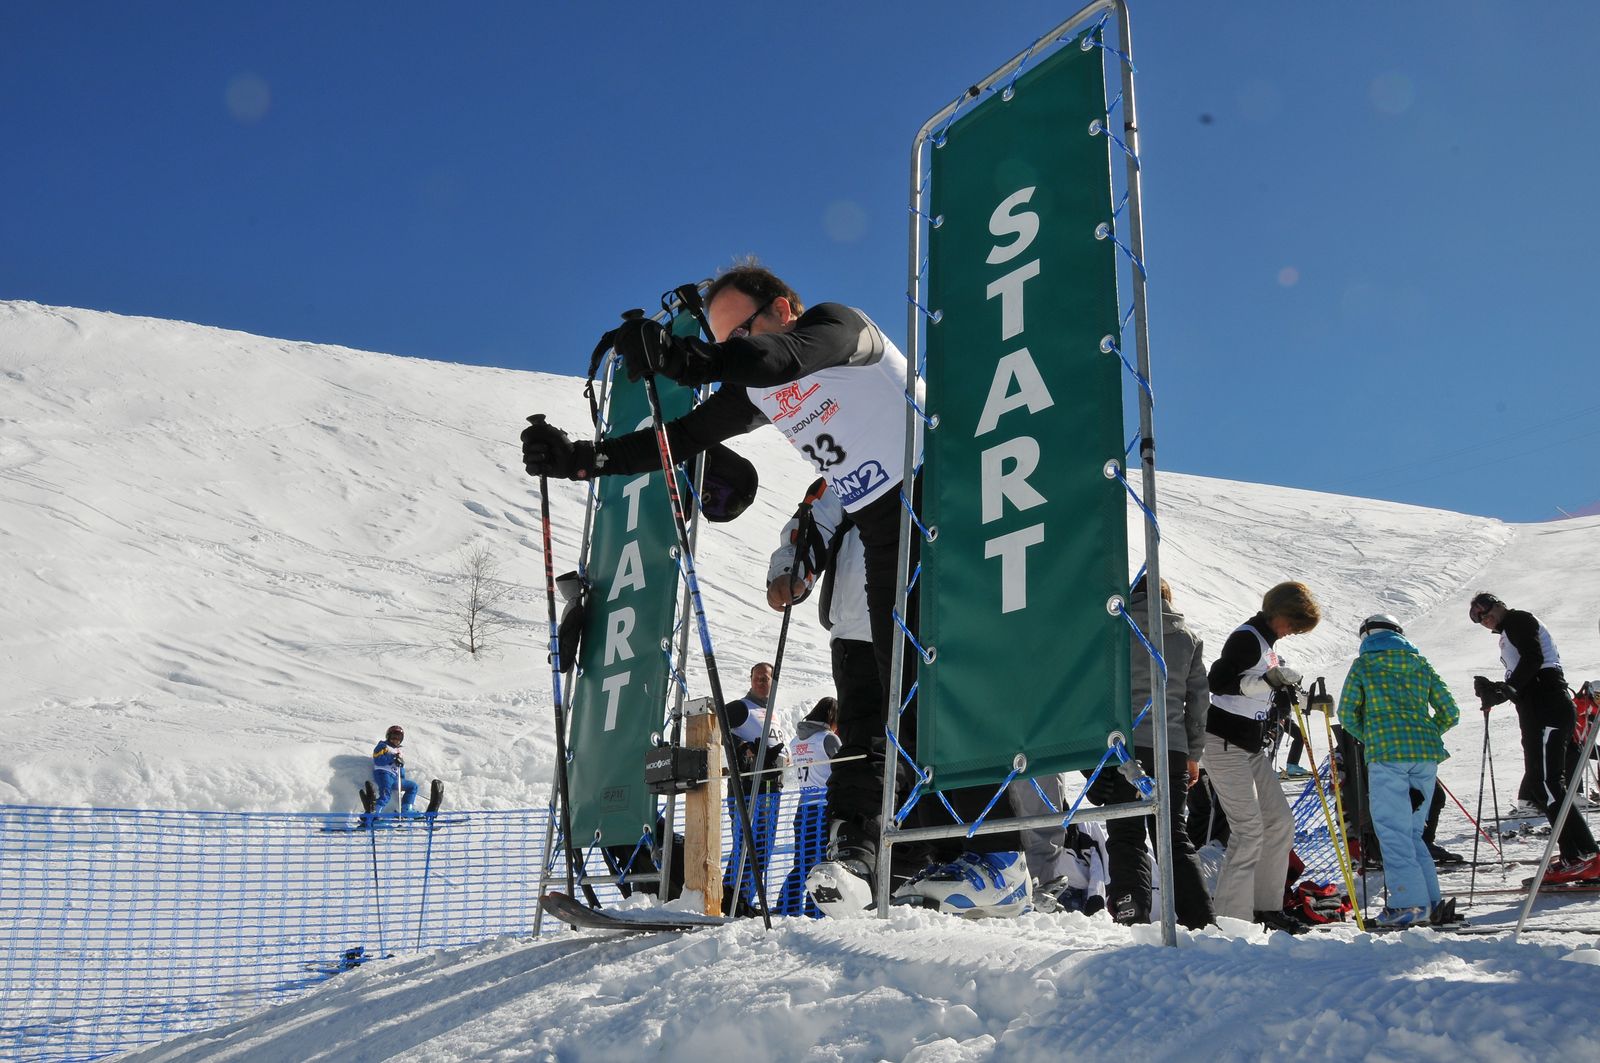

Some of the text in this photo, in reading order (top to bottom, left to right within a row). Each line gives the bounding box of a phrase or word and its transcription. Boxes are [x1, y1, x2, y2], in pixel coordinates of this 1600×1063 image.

[792, 398, 834, 434] BONALDI
[974, 185, 1055, 614] START
[802, 433, 847, 473] 13
[848, 488, 866, 500] CLUB
